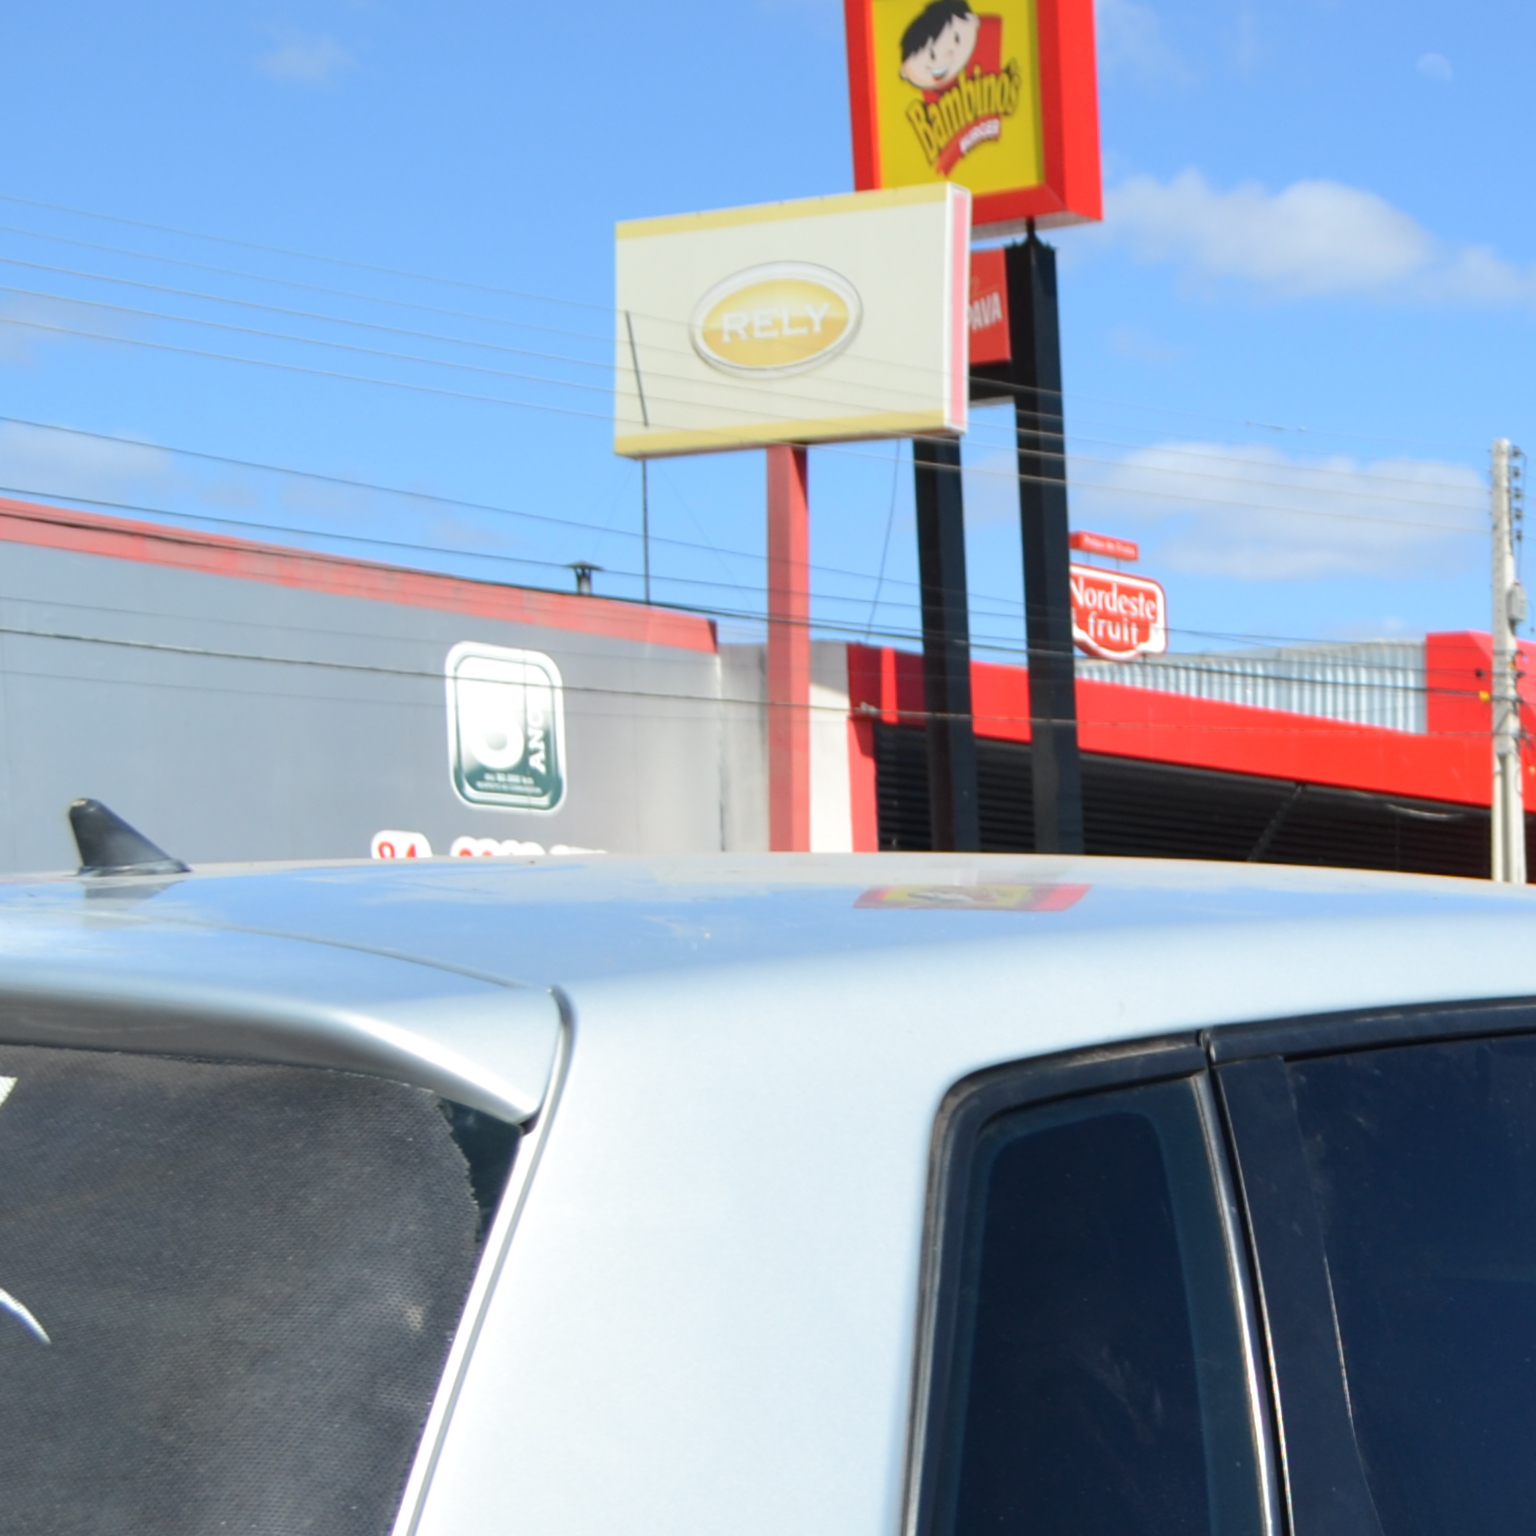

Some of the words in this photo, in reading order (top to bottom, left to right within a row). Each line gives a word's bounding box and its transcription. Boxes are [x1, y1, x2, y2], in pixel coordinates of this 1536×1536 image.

[720, 302, 832, 344] RELY
[1070, 574, 1157, 620] Nordeste
[1088, 611, 1138, 646] fruit
